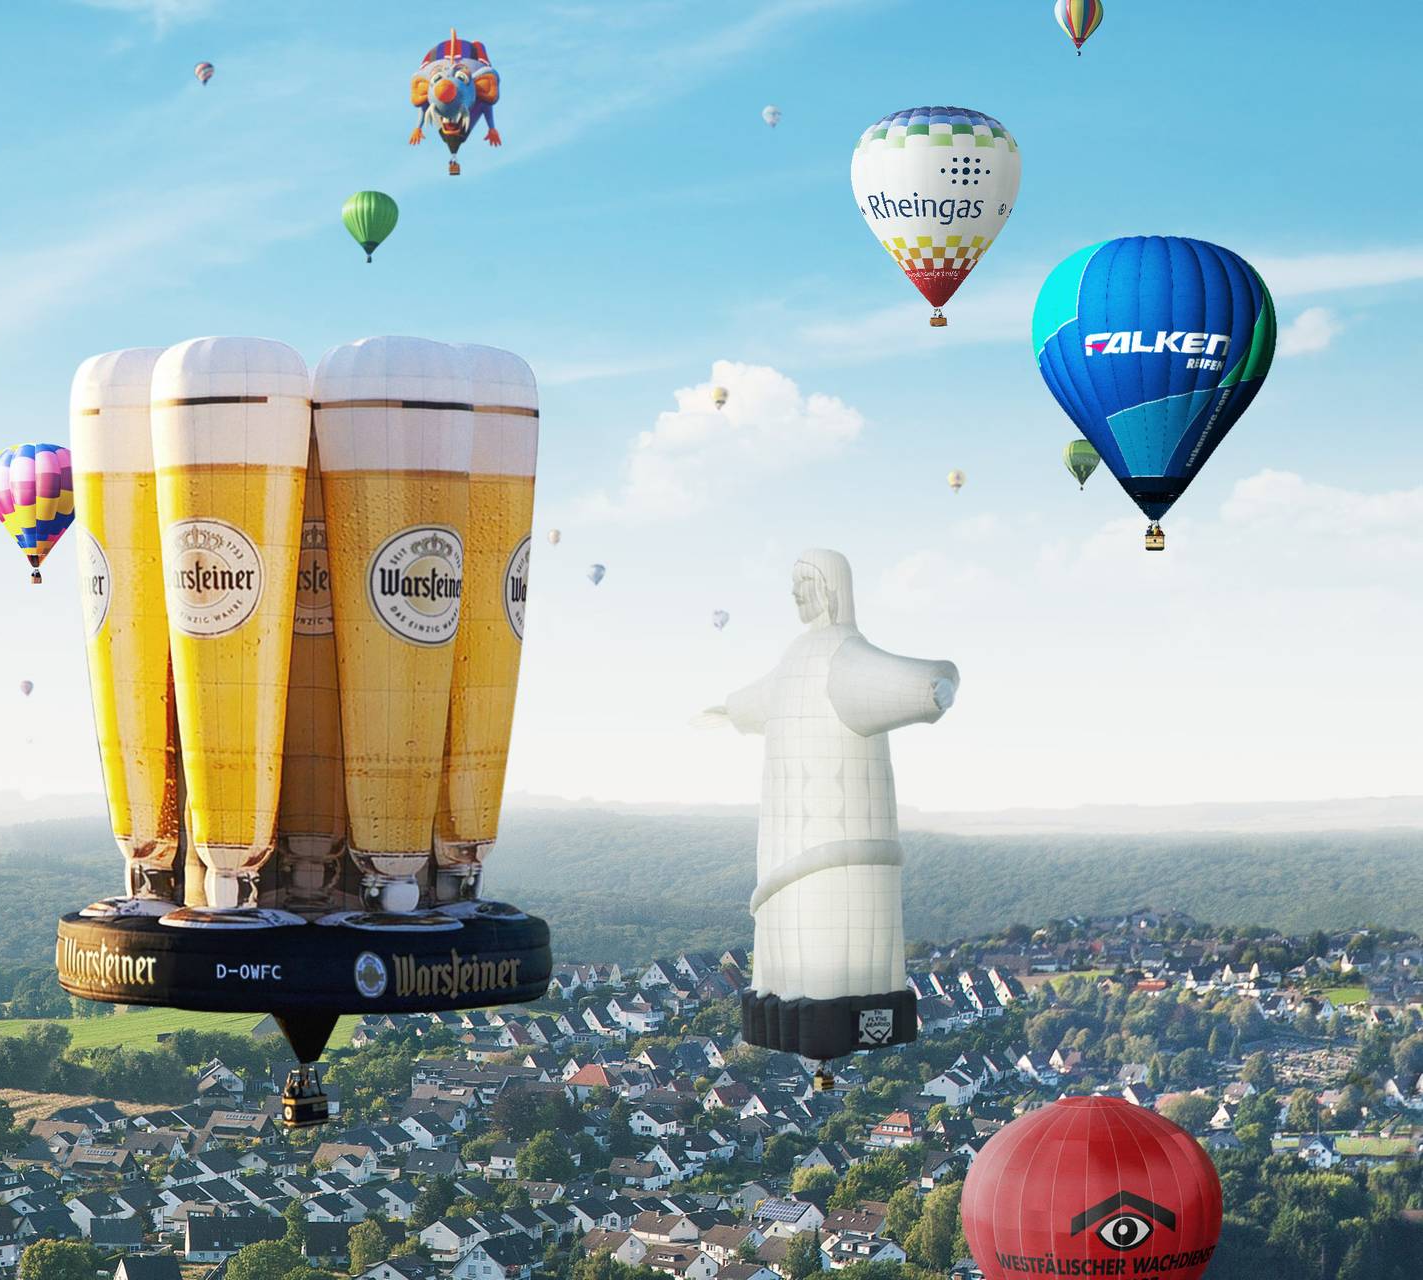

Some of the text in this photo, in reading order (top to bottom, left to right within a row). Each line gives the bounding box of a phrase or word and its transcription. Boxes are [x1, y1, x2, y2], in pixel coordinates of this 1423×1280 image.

[867, 191, 984, 225] Rheingas
[1085, 331, 1231, 356] FALKEN
[1186, 358, 1225, 371] REIFEN
[379, 567, 462, 602] Warsteine
[63, 937, 521, 999] Warsteiner D-OWFC Warsteiner
[995, 1251, 1126, 1276] WESTFÄLISCHER
